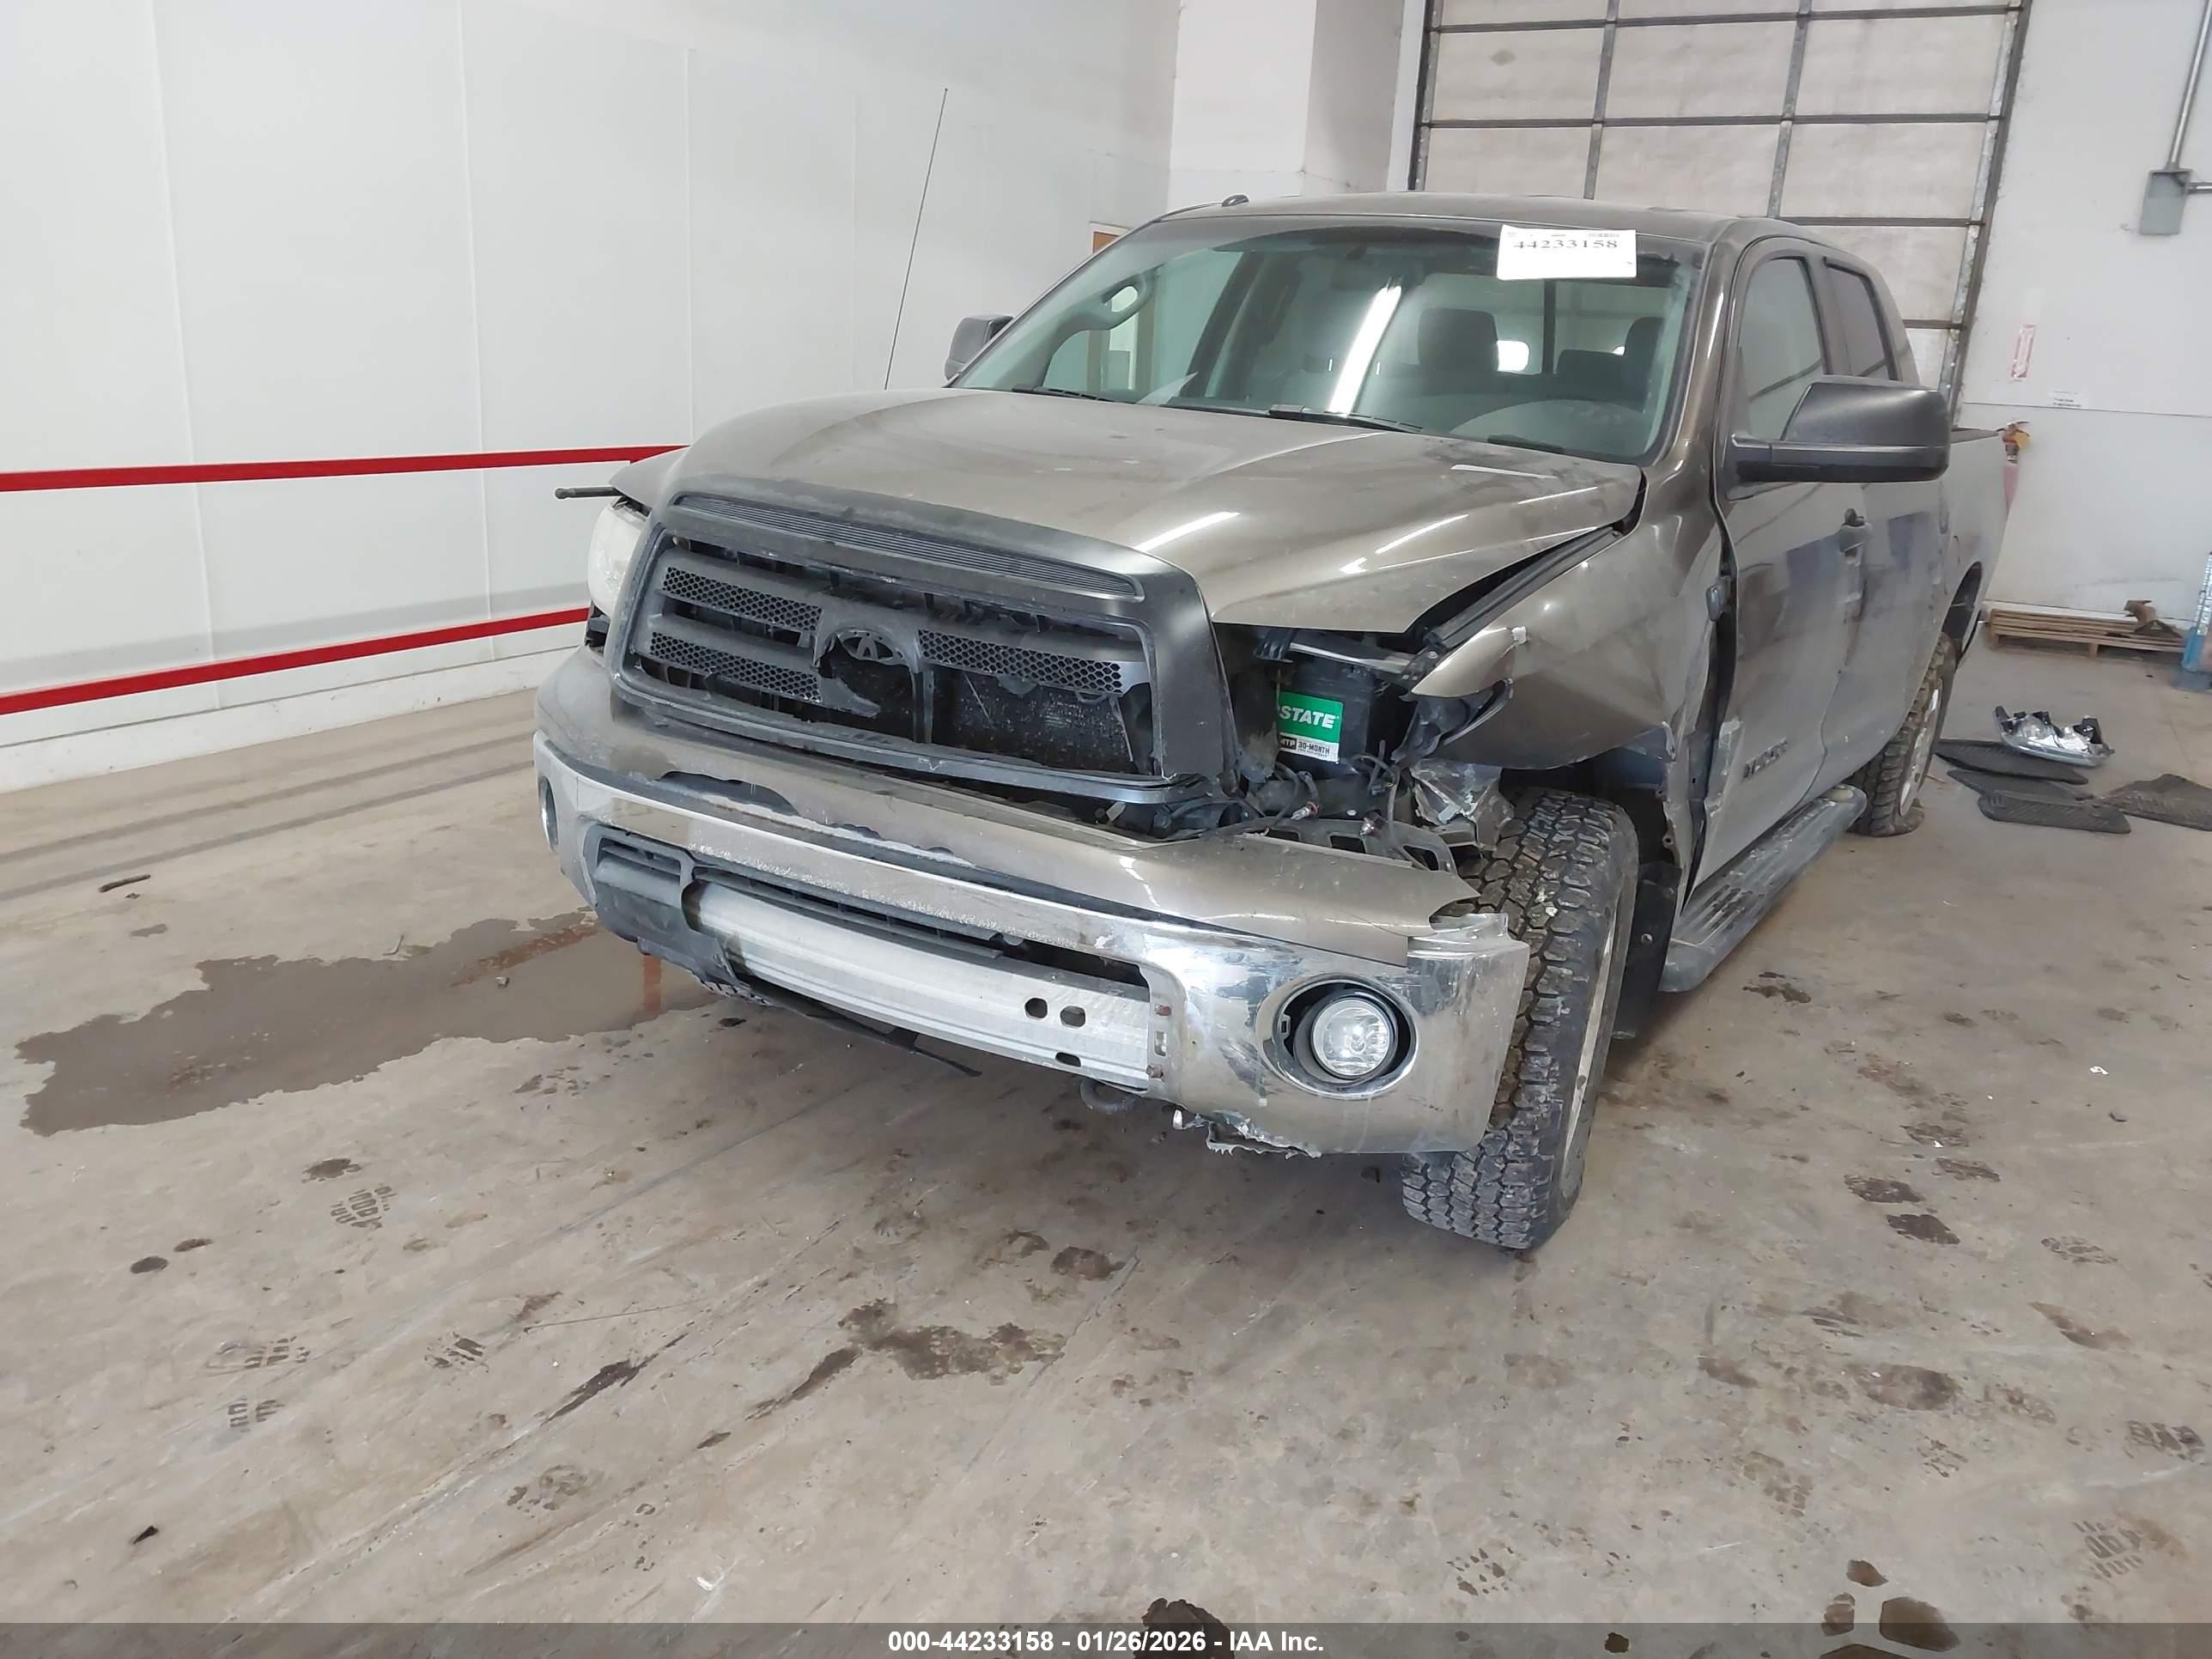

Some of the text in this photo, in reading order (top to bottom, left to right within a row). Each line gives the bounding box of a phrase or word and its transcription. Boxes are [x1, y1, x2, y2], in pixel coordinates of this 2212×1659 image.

[1513, 240, 1619, 249] 44233158
[1278, 705, 1335, 729] STATE
[1297, 741, 1330, 754] 30-MONTH
